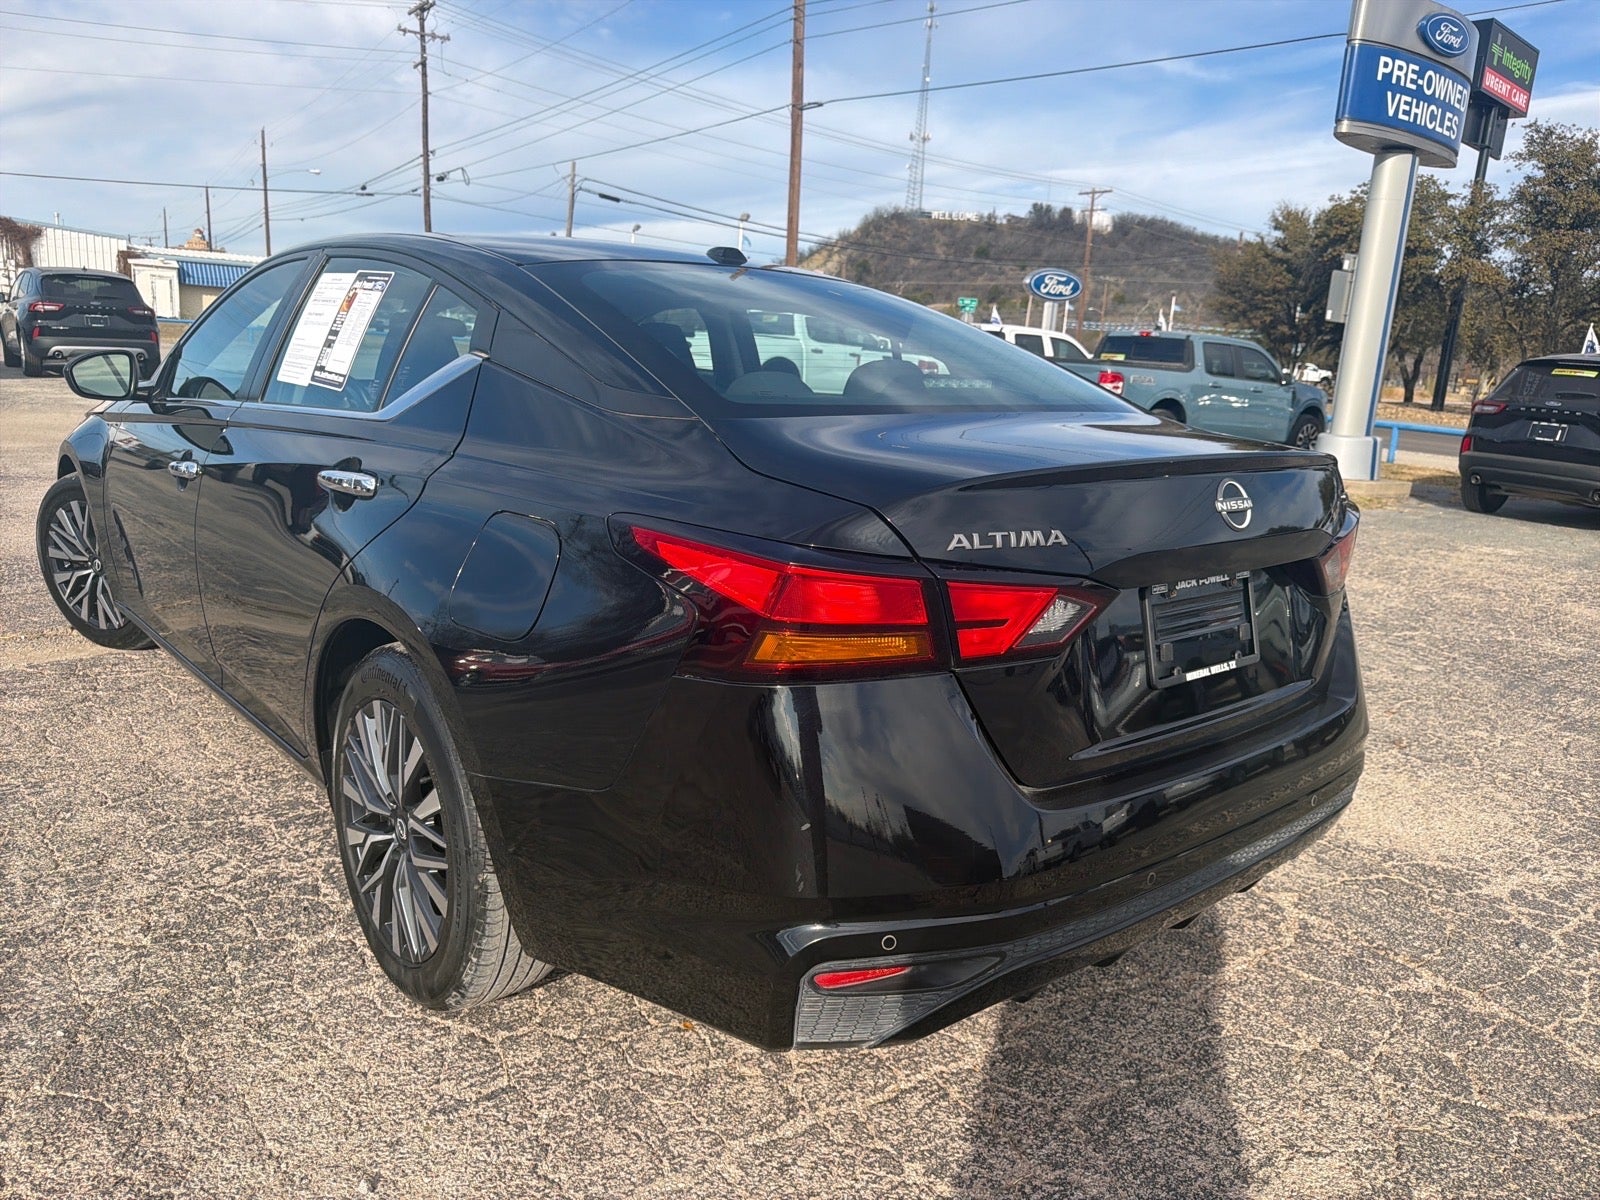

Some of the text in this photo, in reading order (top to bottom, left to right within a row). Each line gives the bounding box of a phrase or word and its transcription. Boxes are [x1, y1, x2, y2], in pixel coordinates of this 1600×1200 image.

[1435, 22, 1464, 49] Ford
[1502, 47, 1532, 85] Integrity
[1376, 55, 1468, 113] PRE-OWNED
[1485, 71, 1528, 109] URGENT CARE
[1387, 91, 1459, 140] VEHICLES
[1040, 274, 1074, 296] Ford
[1217, 499, 1253, 511] NISSAN
[947, 529, 1069, 551] ALTIMA
[1175, 579, 1198, 590] JACK
[1199, 573, 1230, 586] POWELL
